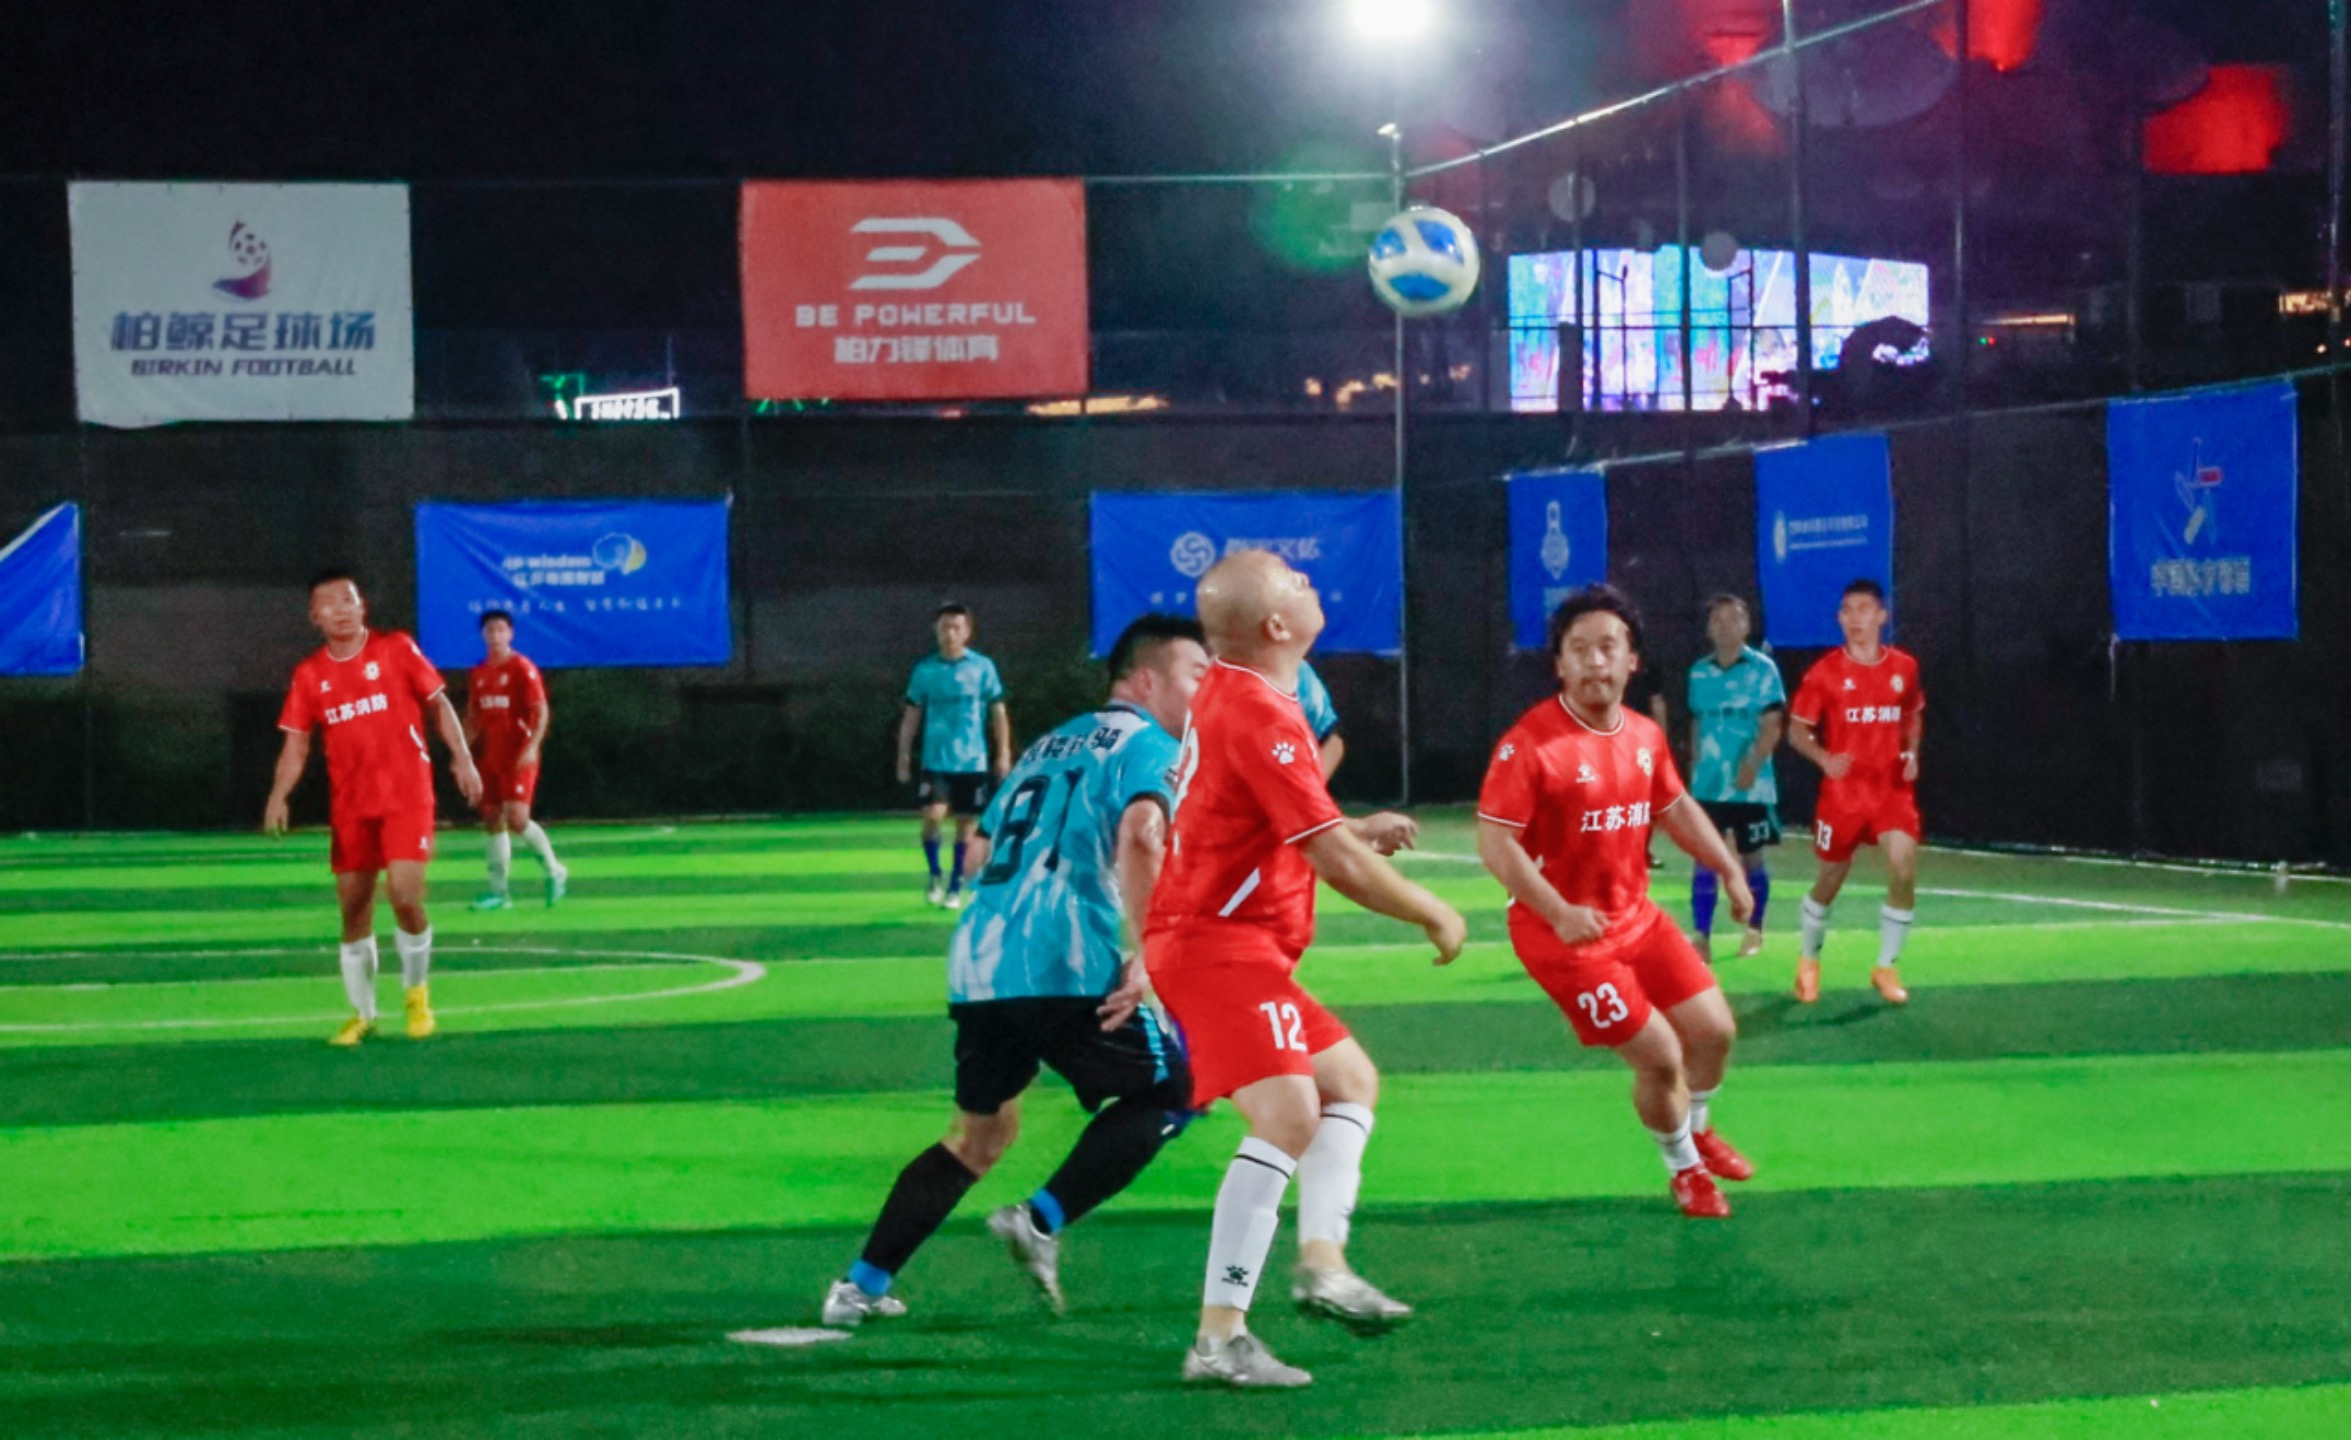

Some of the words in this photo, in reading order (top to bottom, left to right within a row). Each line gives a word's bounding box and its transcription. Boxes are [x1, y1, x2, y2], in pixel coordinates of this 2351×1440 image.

[110, 311, 375, 351] 柏鲸足球场
[795, 305, 838, 327] BE
[855, 303, 1036, 326] POWERFUL
[131, 358, 222, 376] BIRKIN
[231, 358, 355, 376] FOOTBALL
[1577, 982, 1629, 1029] 23
[1259, 1001, 1308, 1052] 12
